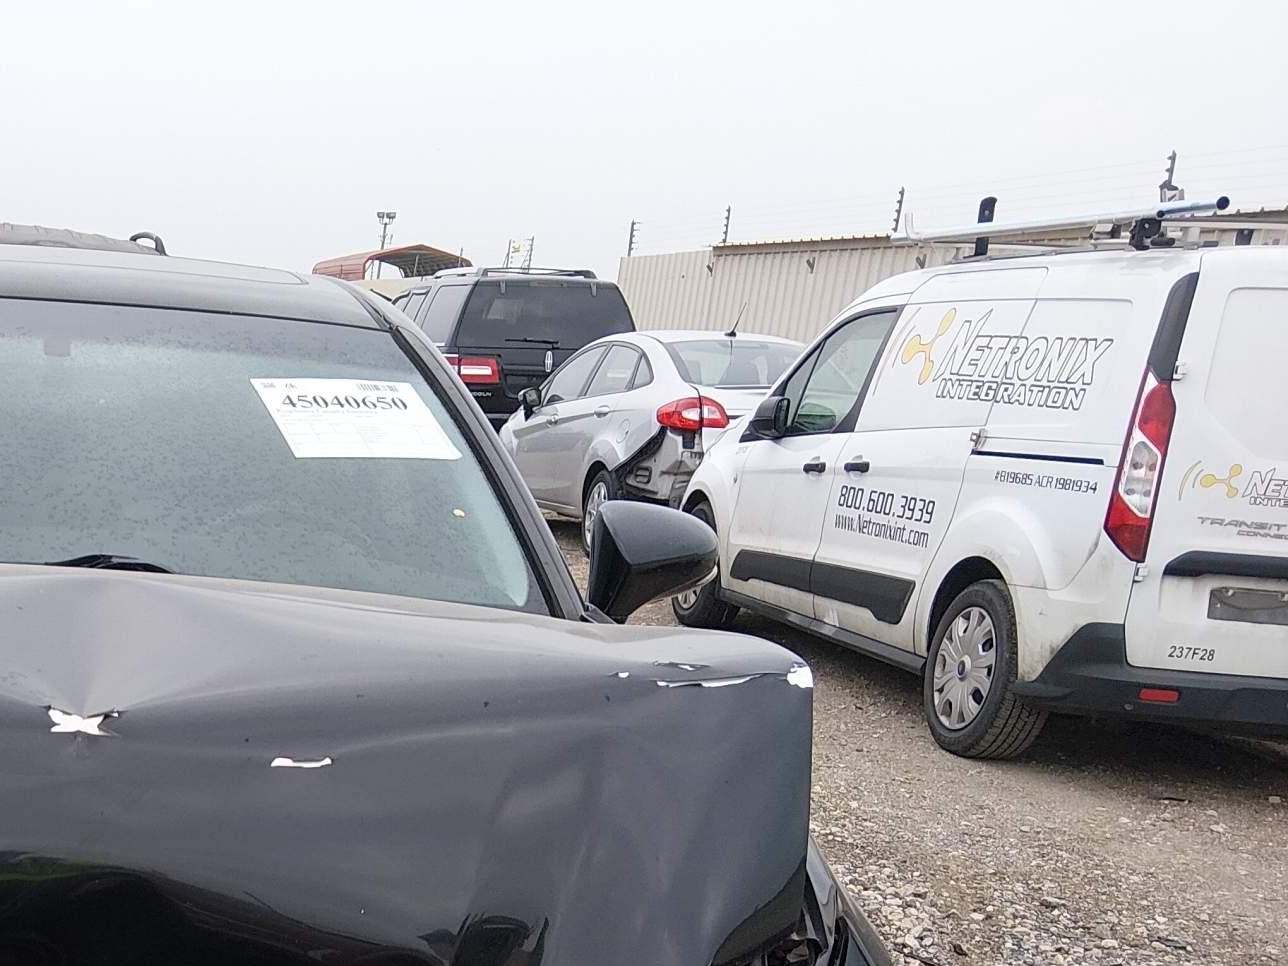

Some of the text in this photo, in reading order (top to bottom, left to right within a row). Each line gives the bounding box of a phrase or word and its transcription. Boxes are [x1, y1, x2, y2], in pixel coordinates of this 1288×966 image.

[281, 394, 408, 411] 45040650
[936, 378, 1086, 410] INTEGRATION
[994, 470, 1098, 494] #819685 ACR 1981934
[838, 485, 935, 524] 800.600.3939
[835, 513, 929, 549] www.Netronixint.com
[1197, 516, 1288, 532] TRANSIT
[1168, 645, 1215, 661] 237F28
